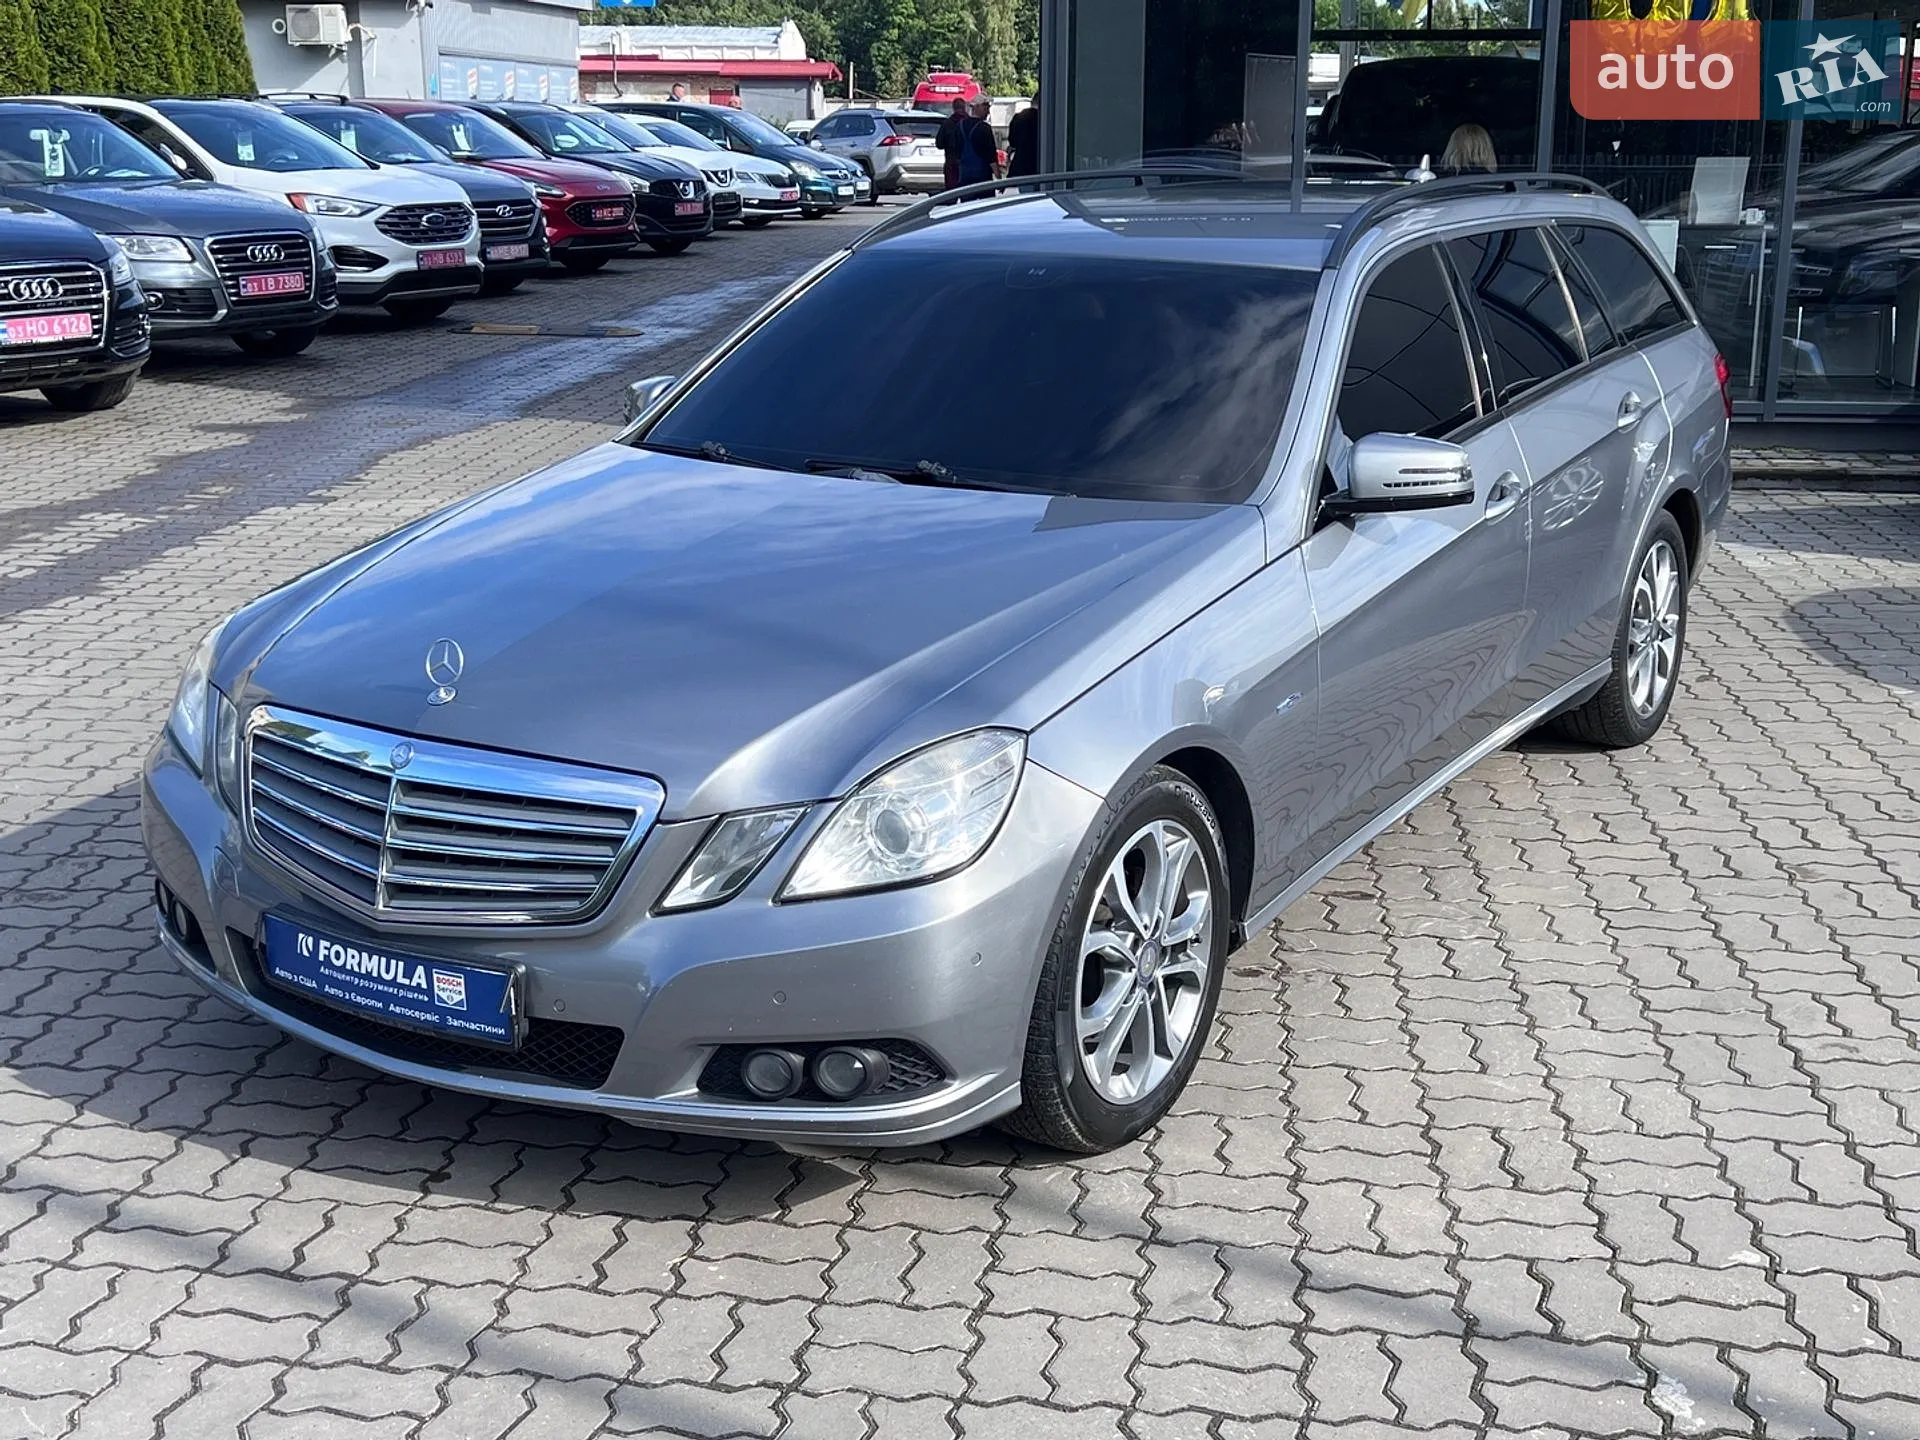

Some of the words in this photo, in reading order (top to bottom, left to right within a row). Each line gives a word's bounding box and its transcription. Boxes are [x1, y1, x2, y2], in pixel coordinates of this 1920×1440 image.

[53, 316, 88, 335] 6126
[319, 939, 427, 989] FORMULA
[320, 966, 359, 985] Автоцентр
[399, 988, 429, 1002] рішень
[436, 975, 463, 987] BOSCH
[437, 984, 463, 996] Service
[275, 966, 292, 981] Авто
[298, 975, 318, 989] США
[324, 984, 344, 998] Авто
[350, 992, 383, 1009] Європи
[389, 1003, 440, 1023] Автосервіс
[446, 1016, 505, 1035] Запчастини
